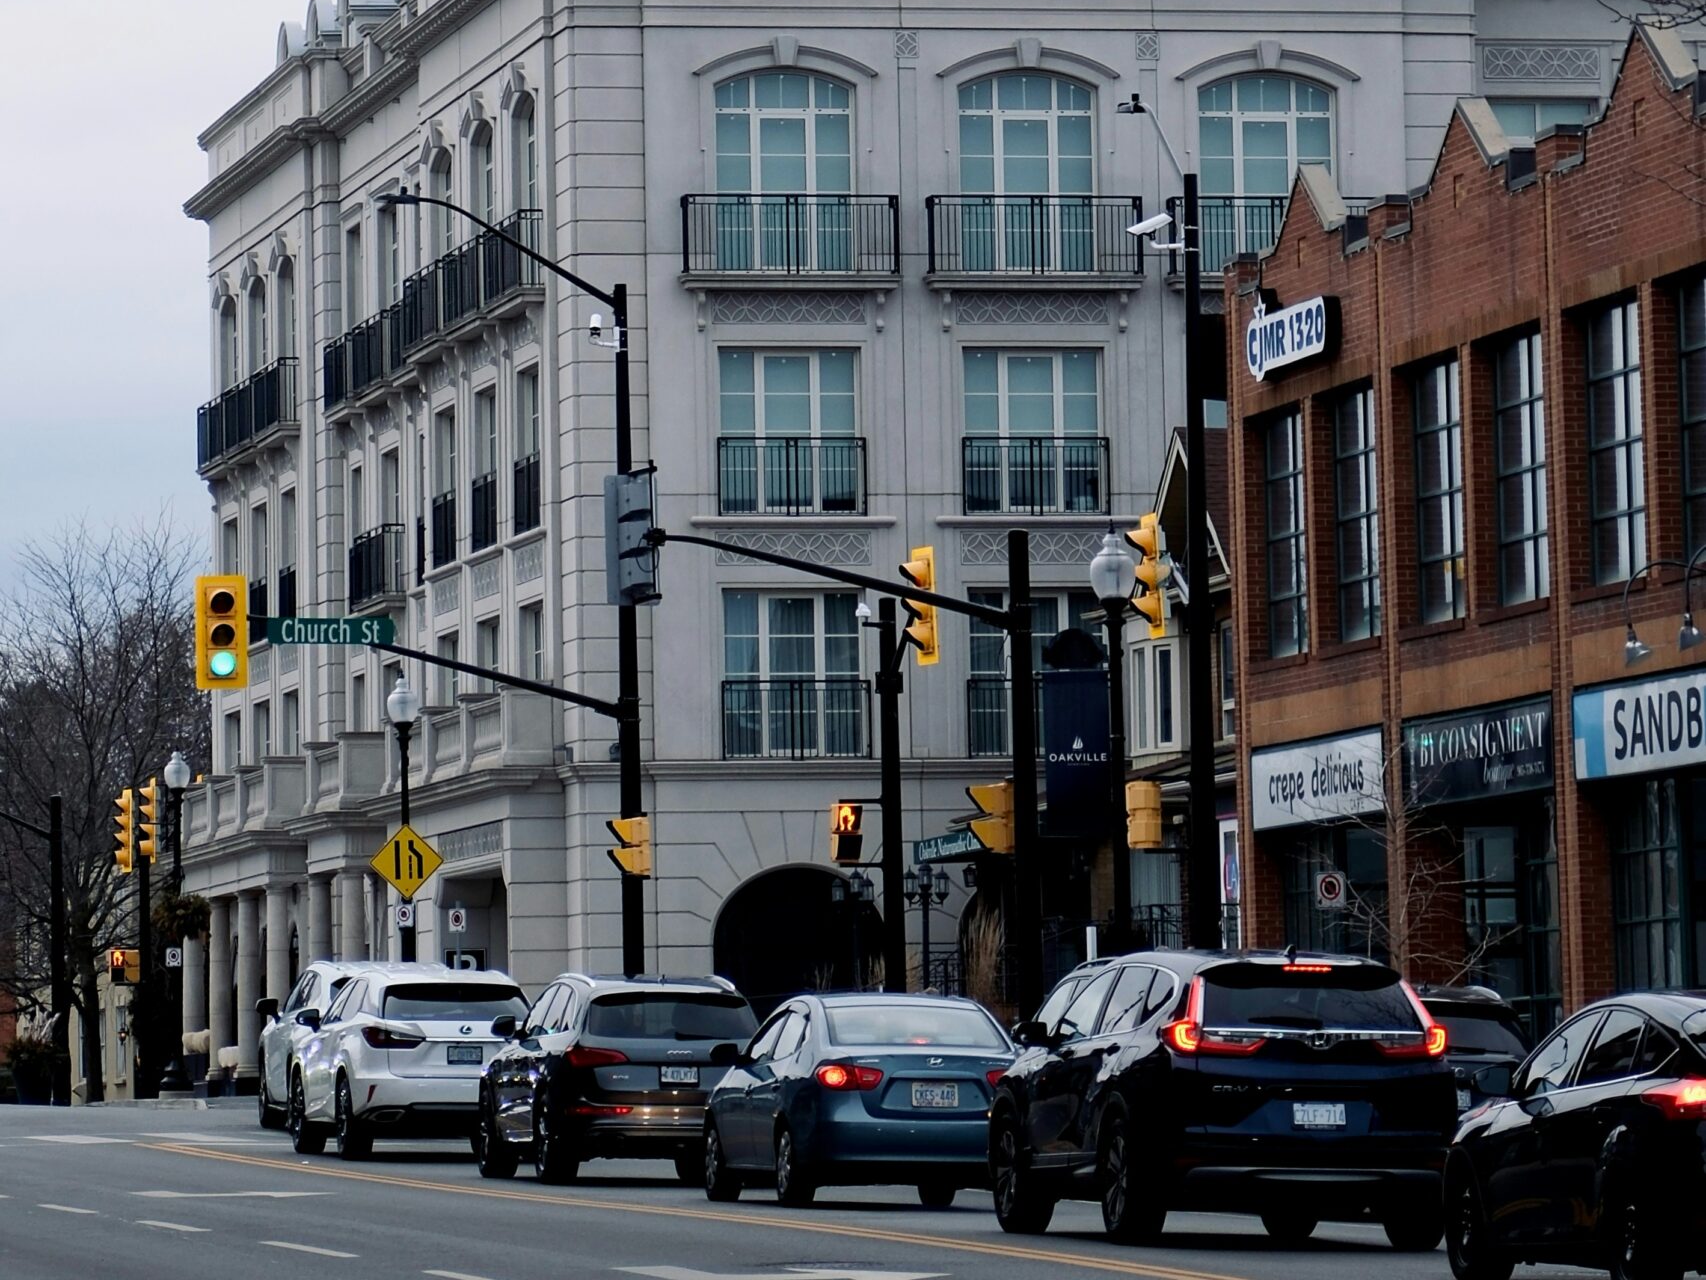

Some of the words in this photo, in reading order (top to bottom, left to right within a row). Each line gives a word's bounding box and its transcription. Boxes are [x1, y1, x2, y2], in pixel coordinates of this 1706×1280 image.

[1248, 319, 1286, 373] CJMR
[1289, 304, 1324, 352] 1320
[281, 618, 350, 643] Church
[361, 620, 380, 643] St
[1419, 731, 1437, 768] BY
[1438, 711, 1546, 764] CONSIGNMENT
[1613, 687, 1706, 760] SANDB
[1049, 752, 1107, 762] OAKVILLE
[1269, 771, 1305, 815] crepe
[1311, 752, 1364, 798] delicious
[1212, 1085, 1249, 1093] CR-V
